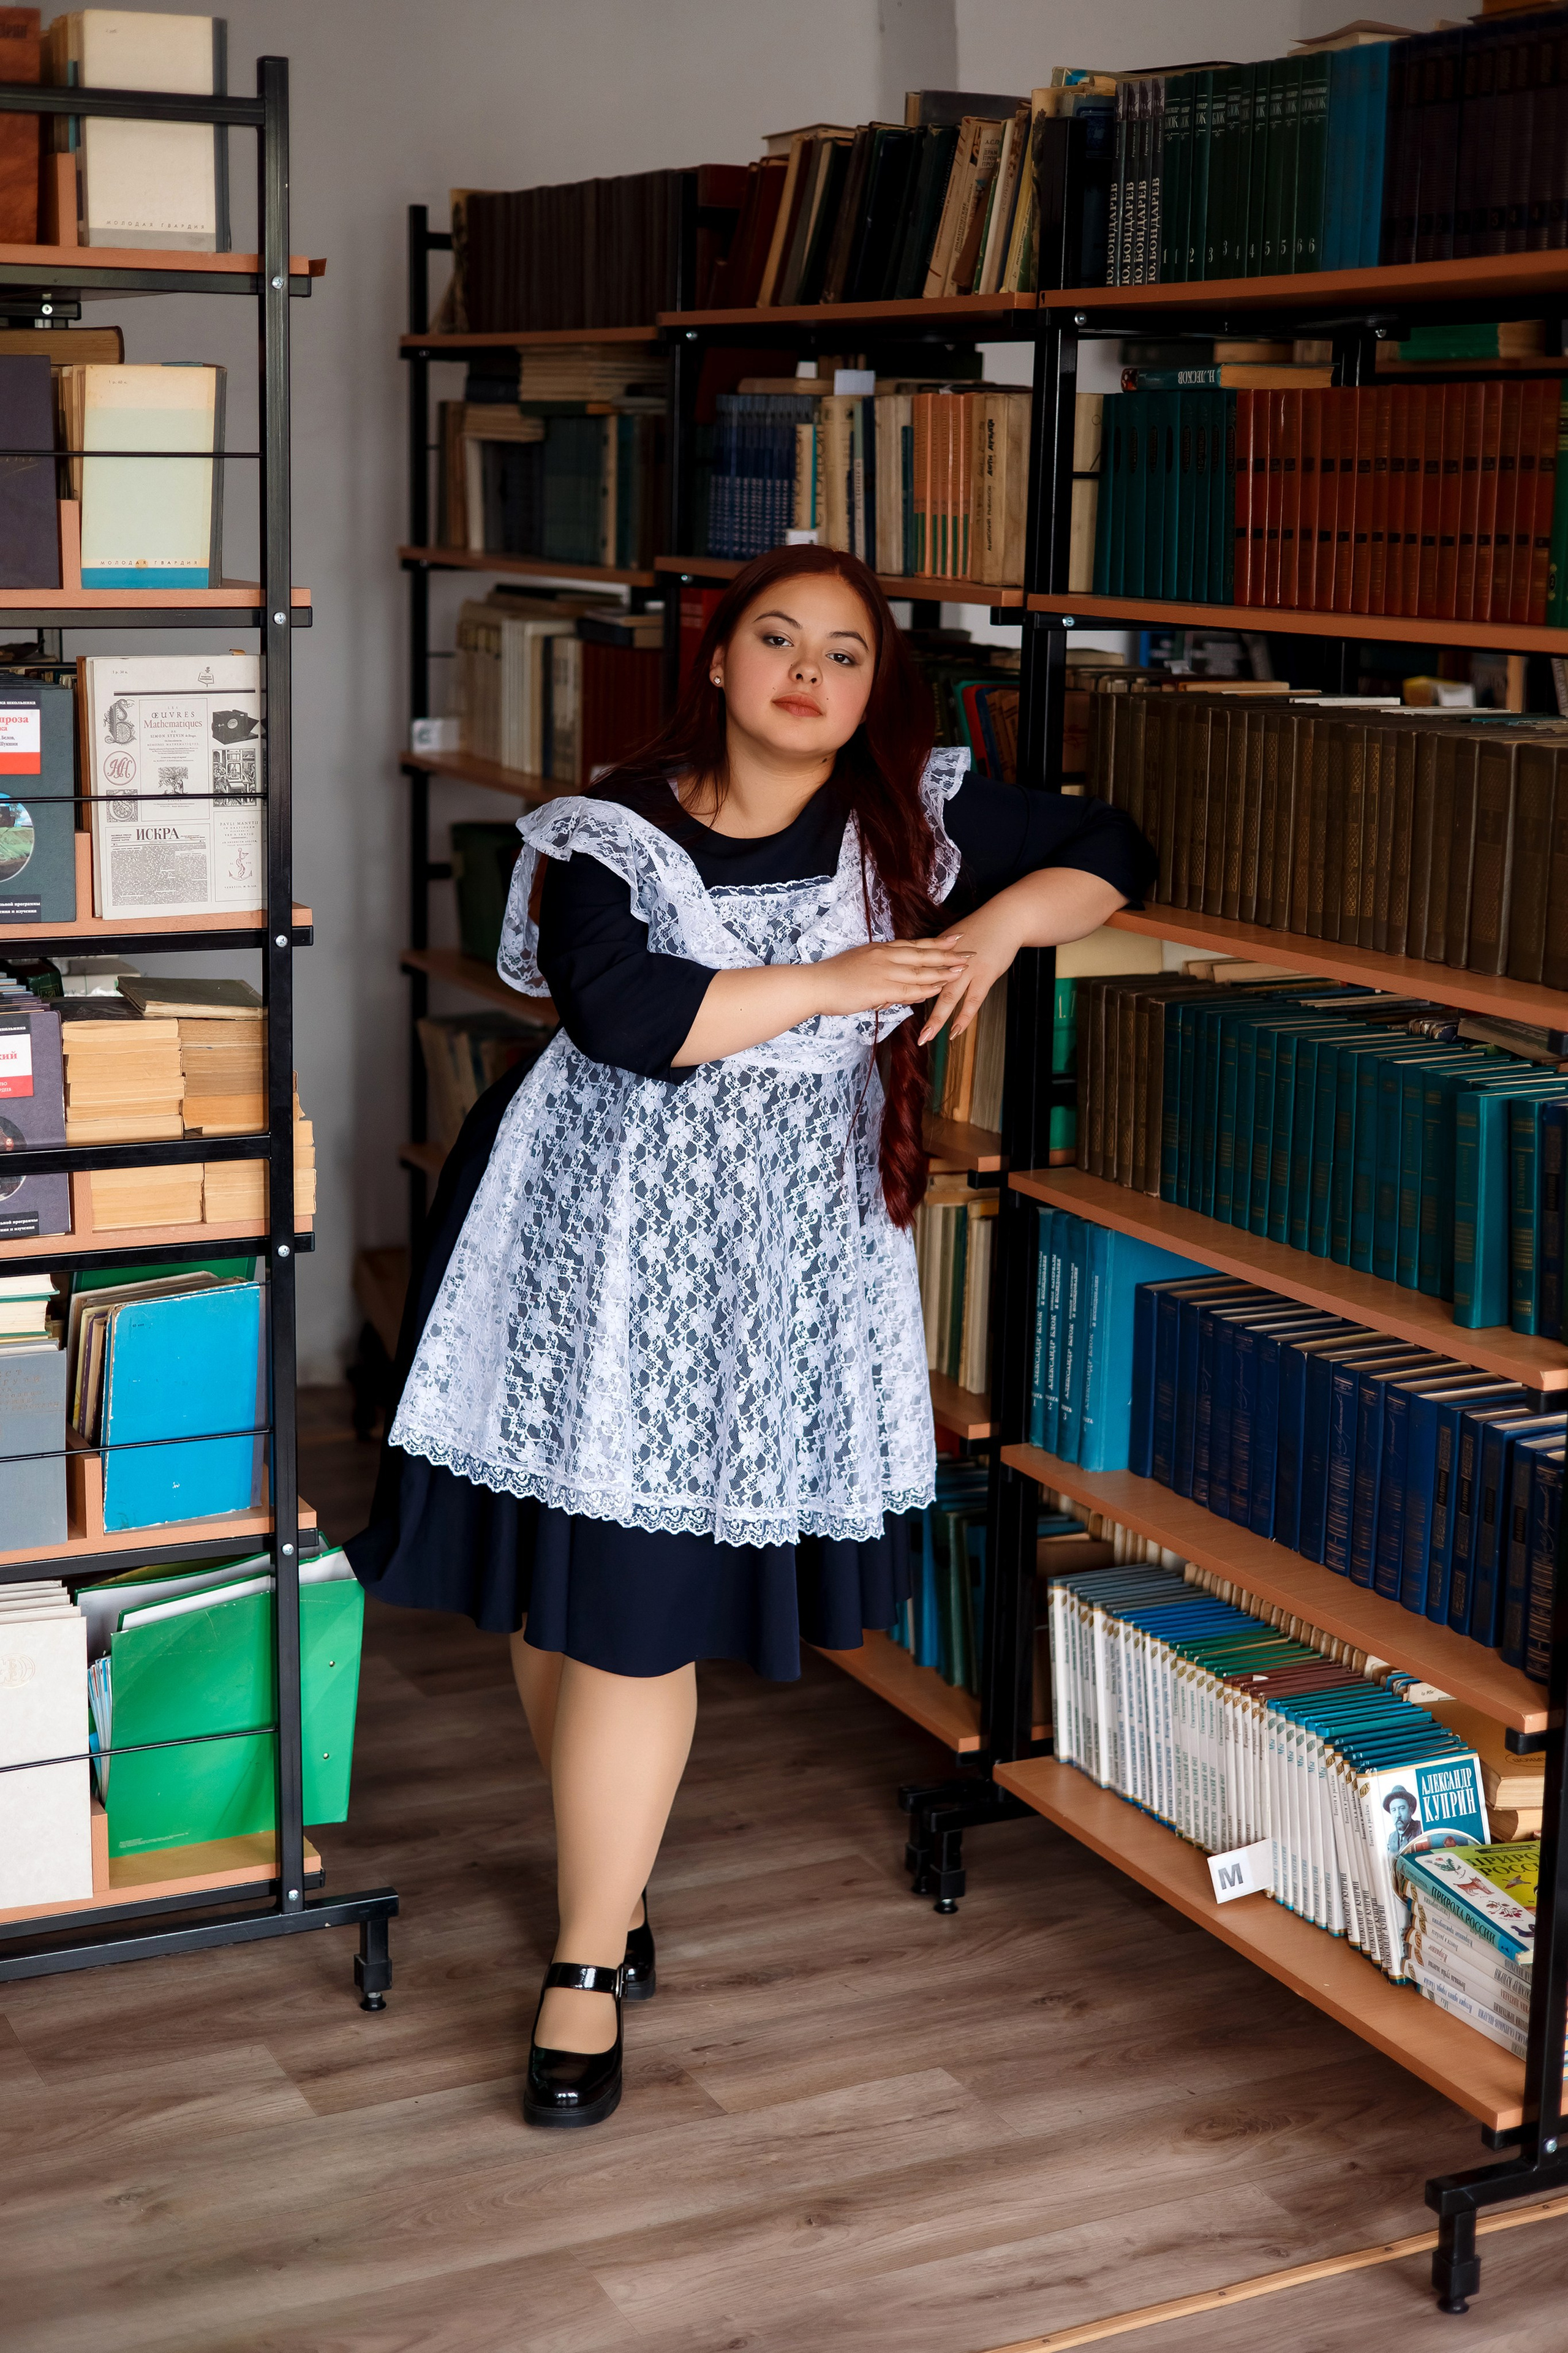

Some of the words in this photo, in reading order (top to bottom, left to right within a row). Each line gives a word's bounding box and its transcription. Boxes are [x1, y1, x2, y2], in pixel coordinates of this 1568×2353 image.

[1107, 182, 1119, 263] БОНДАРЕВ
[1124, 181, 1135, 263] БОНДАРЕВ
[1136, 179, 1148, 263] БОНДАРЕВ
[1149, 177, 1161, 258] БОНДАРЕВ
[1189, 247, 1195, 263] 2
[1208, 247, 1214, 263] 3
[1223, 240, 1228, 256] 3
[1249, 244, 1255, 258] 4
[1265, 240, 1271, 256] 5
[1281, 239, 1287, 255] 5
[1297, 238, 1302, 254] 6
[1308, 238, 1315, 254] 6
[1163, 248, 1167, 264] 1
[1106, 266, 1114, 285] Ю.
[1122, 265, 1131, 285] Ю.
[1135, 264, 1144, 284] Ю.
[1148, 261, 1156, 282] Ю.
[1178, 370, 1207, 384] ЛЕСКОВ
[1208, 369, 1215, 383] Н.
[144, 719, 203, 729] Mathematiques
[136, 827, 179, 840] ИСКРА
[1048, 1340, 1056, 1390] АЛЕКСАНДР
[1064, 1348, 1072, 1400] АЛЕКСАНДР
[1033, 1398, 1036, 1407] 1
[1063, 1412, 1067, 1420] 3
[1268, 1738, 1276, 1751] Мы
[1278, 1743, 1285, 1755] Мы
[1287, 1751, 1294, 1763] Мы
[1297, 1755, 1304, 1767] Мы
[1308, 1761, 1315, 1774] Мы
[1319, 1766, 1326, 1780] Мы
[1422, 1767, 1472, 1796] АЛЕКСАНДР
[1422, 1788, 1477, 1822] КУПРИН
[1217, 1863, 1244, 1890] М
[1340, 1872, 1349, 1898] КУПРИН
[1352, 1881, 1362, 1907] КУПРИН
[1363, 1890, 1372, 1916] КУПРИН
[1342, 1900, 1353, 1937] АЛЕКСАНДР
[1378, 1904, 1387, 1931] КУПРИН
[1431, 1885, 1464, 1922] ПРИРОДА
[1465, 1914, 1496, 1946] РОССИИ
[1356, 1908, 1367, 1946] АЛЕКСАНДР
[1366, 1917, 1376, 1955] АЛЕКСАНДР
[1382, 1933, 1393, 1970] АЛЕКСАНДР
[1428, 1945, 1449, 1963] Избранное
[1494, 1968, 1511, 1987] КУПРИН
[1500, 1988, 1519, 2007] ЦВЕТАЕВА
